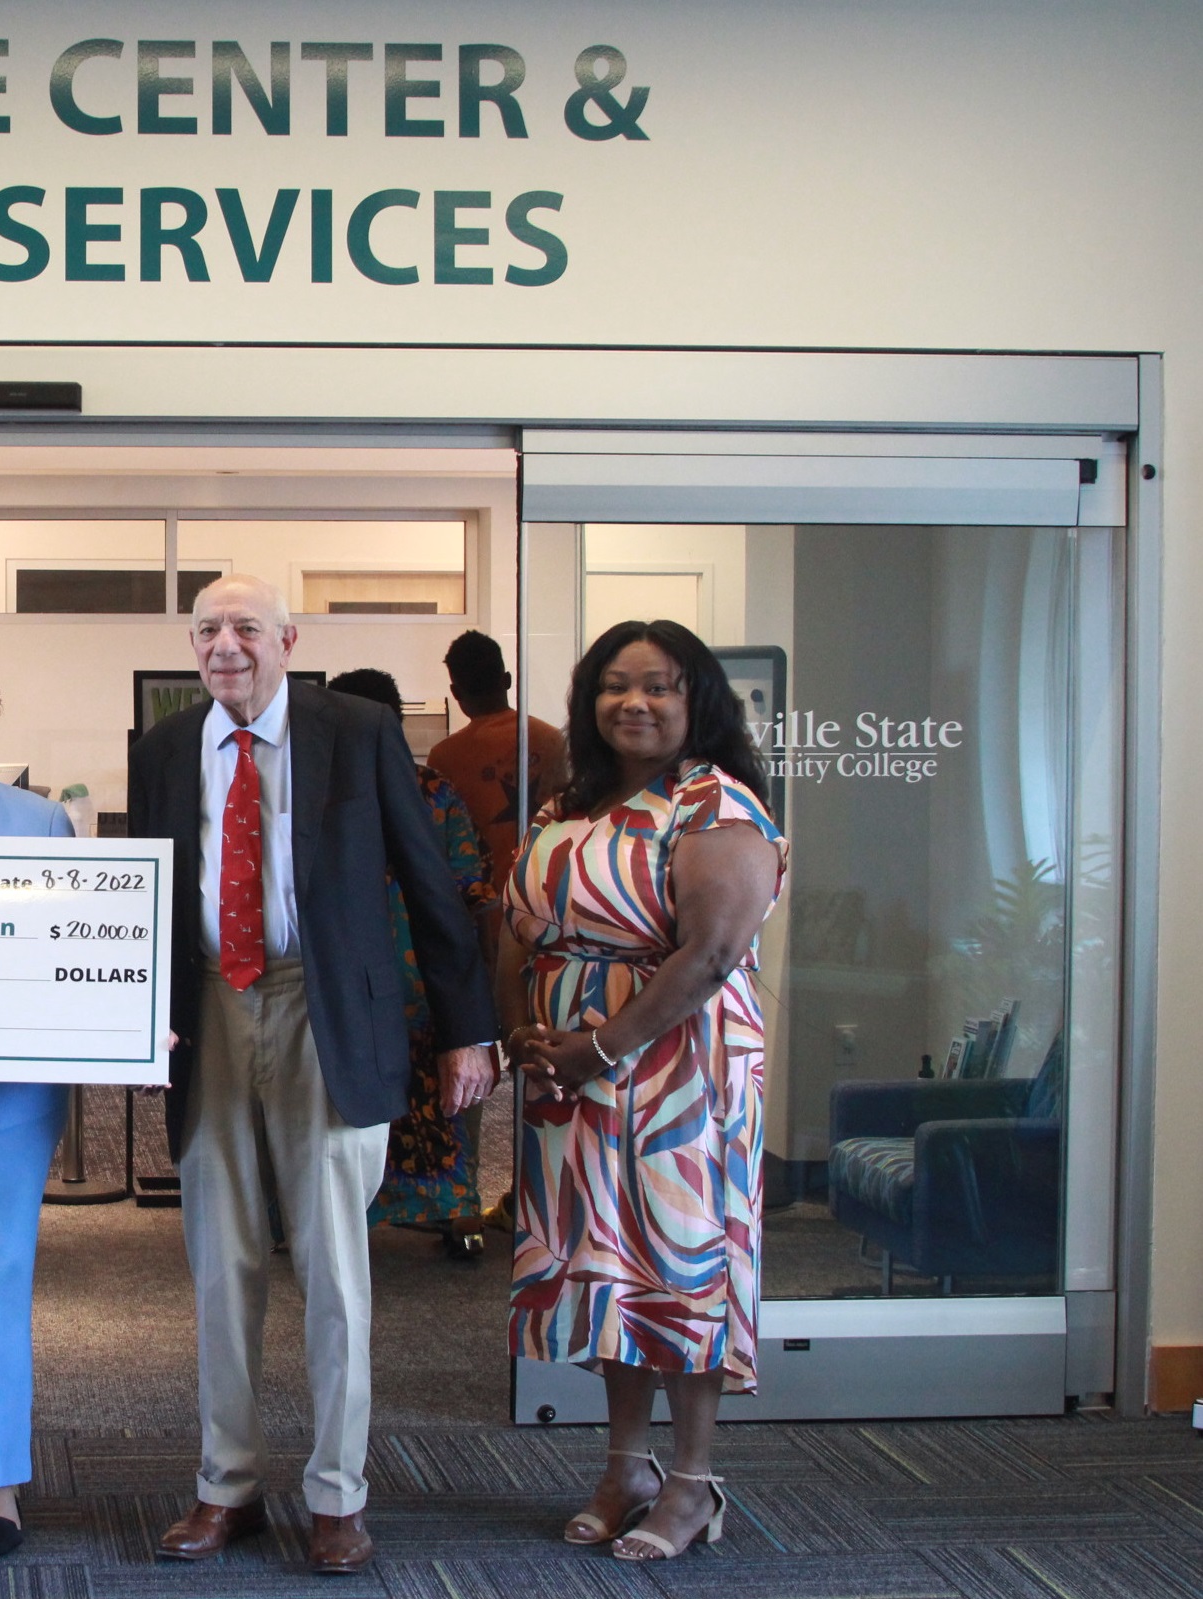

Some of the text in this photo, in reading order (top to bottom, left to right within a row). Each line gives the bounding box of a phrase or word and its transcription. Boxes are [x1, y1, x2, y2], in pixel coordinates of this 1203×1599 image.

[49, 38, 529, 139] CENTER
[564, 44, 651, 141] &
[746, 710, 963, 748] ville State
[836, 753, 938, 783] College
[55, 967, 148, 983] DOLLARS
